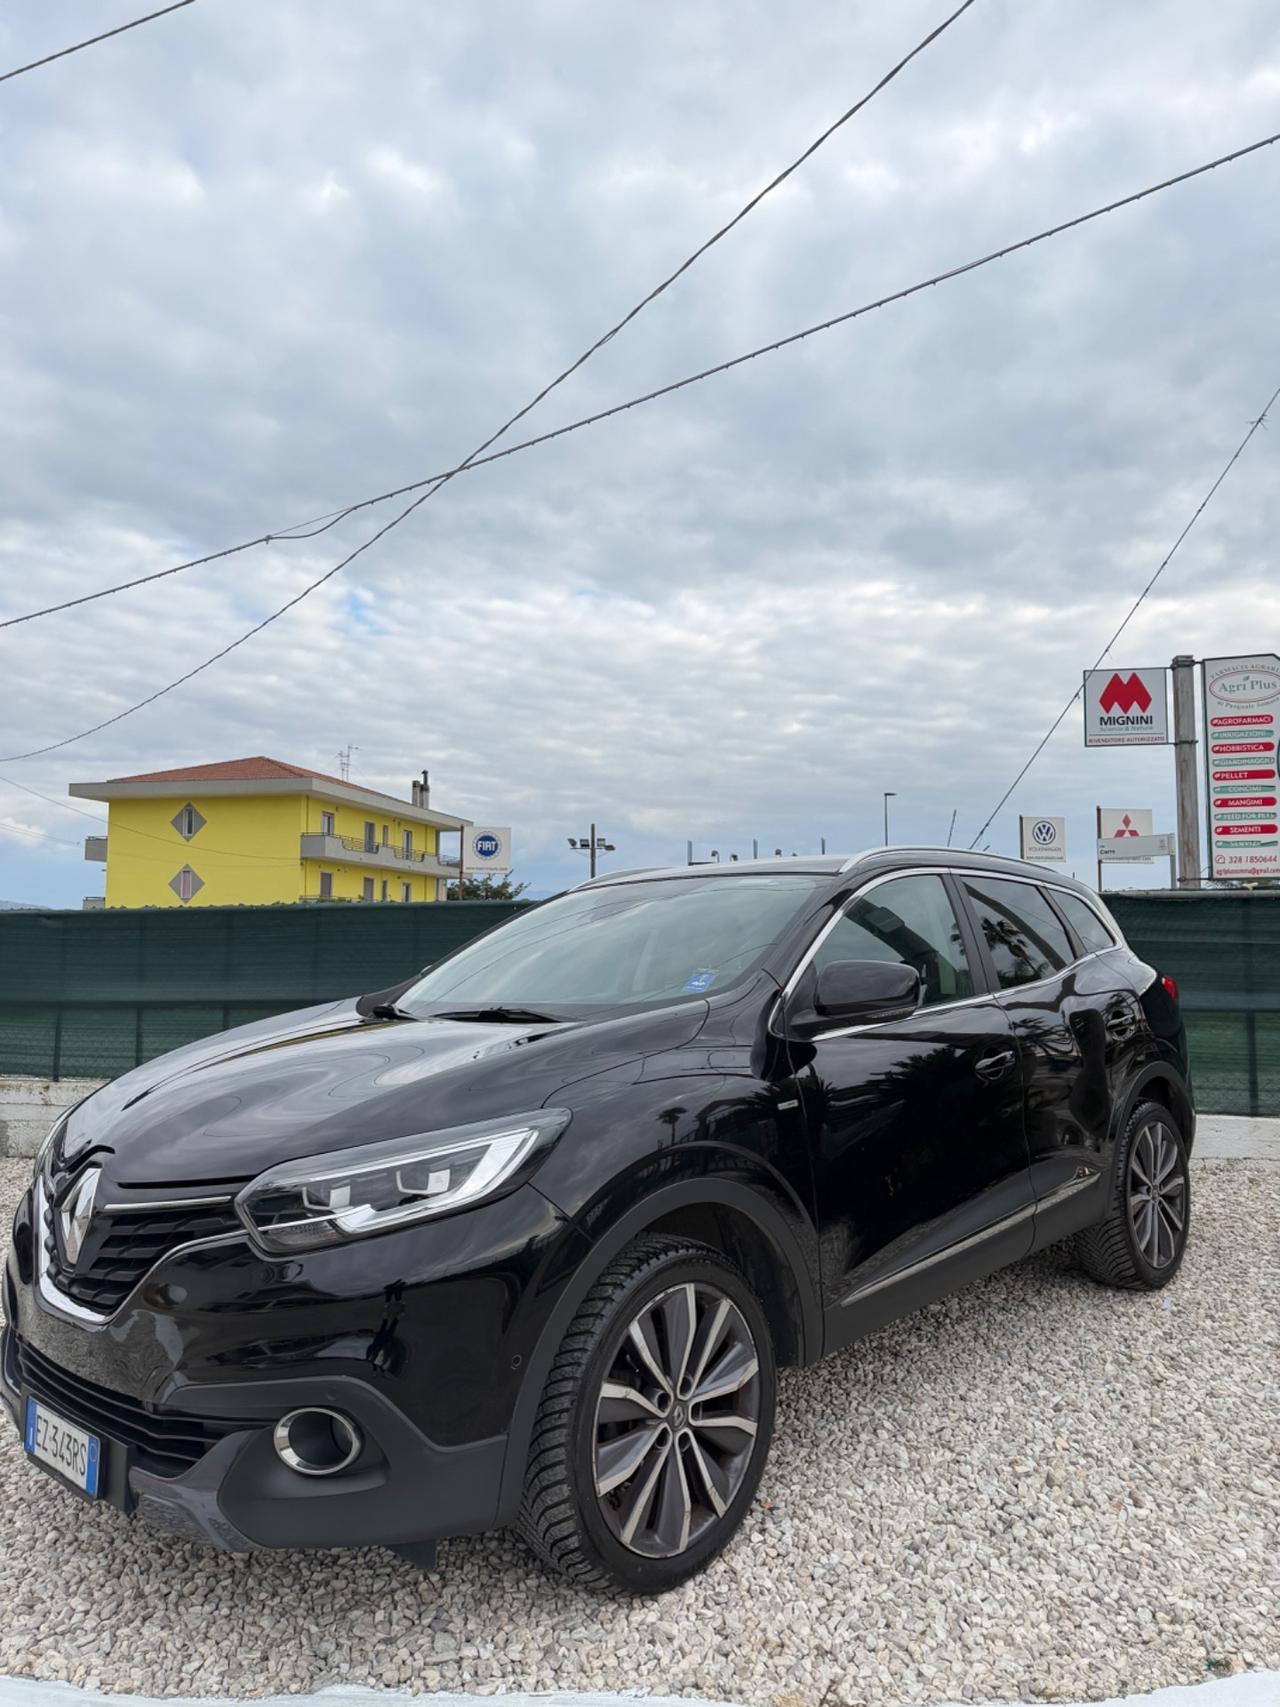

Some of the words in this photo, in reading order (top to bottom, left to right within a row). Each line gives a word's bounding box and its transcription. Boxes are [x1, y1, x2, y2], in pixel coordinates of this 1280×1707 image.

[1219, 683, 1247, 694] Agri
[1250, 680, 1278, 690] Plus
[1099, 715, 1153, 726] MIGNINI
[1217, 717, 1271, 725] AGROFARMACI
[1219, 744, 1264, 752] HOBBISTICA
[478, 841, 497, 851] FIAT
[1229, 855, 1243, 864] 328
[1246, 855, 1278, 863] 1850644
